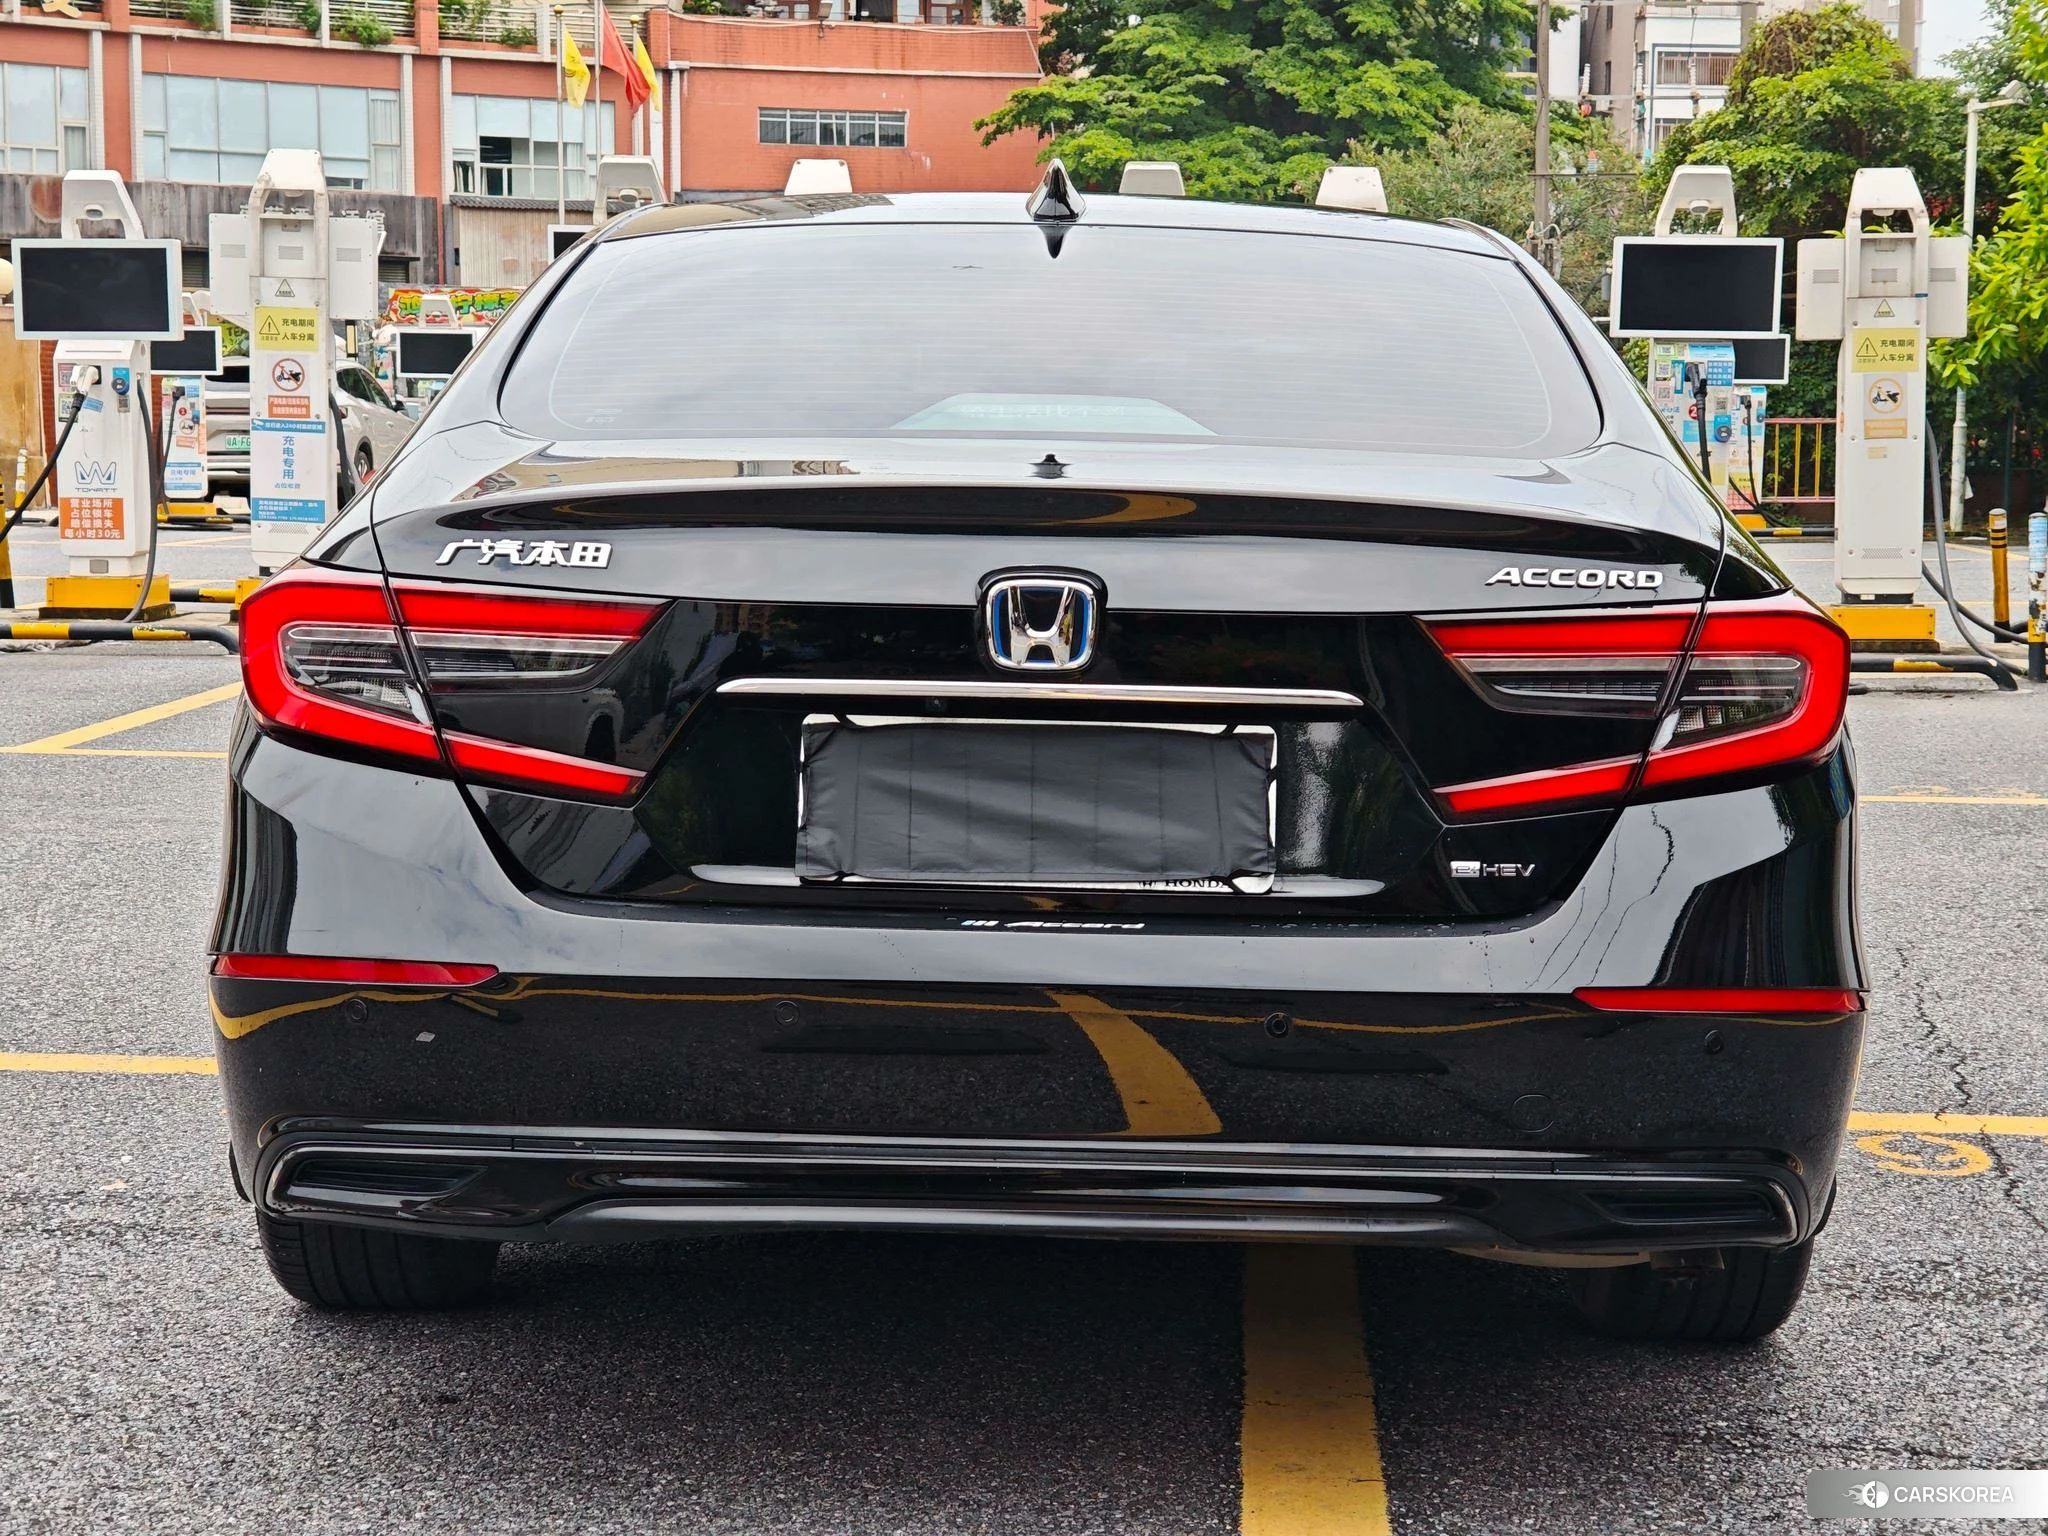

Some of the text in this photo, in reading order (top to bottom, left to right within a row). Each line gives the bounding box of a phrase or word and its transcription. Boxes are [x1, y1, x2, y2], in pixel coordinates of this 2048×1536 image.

[281, 318, 315, 328] 充电期间
[281, 332, 315, 341] 人车分离
[1879, 339, 1915, 348] 充电期间
[1879, 353, 1914, 362] 人车分离
[282, 435, 295, 480] 充电专用
[70, 498, 113, 508] 营业场所
[70, 508, 113, 518] 占位锁车
[70, 518, 114, 528] 赔偿损失
[64, 529, 121, 539] 每小时30元
[435, 538, 612, 569] 广汽本田
[1485, 567, 1664, 590] ACCORD
[1004, 920, 1145, 929] Accord
